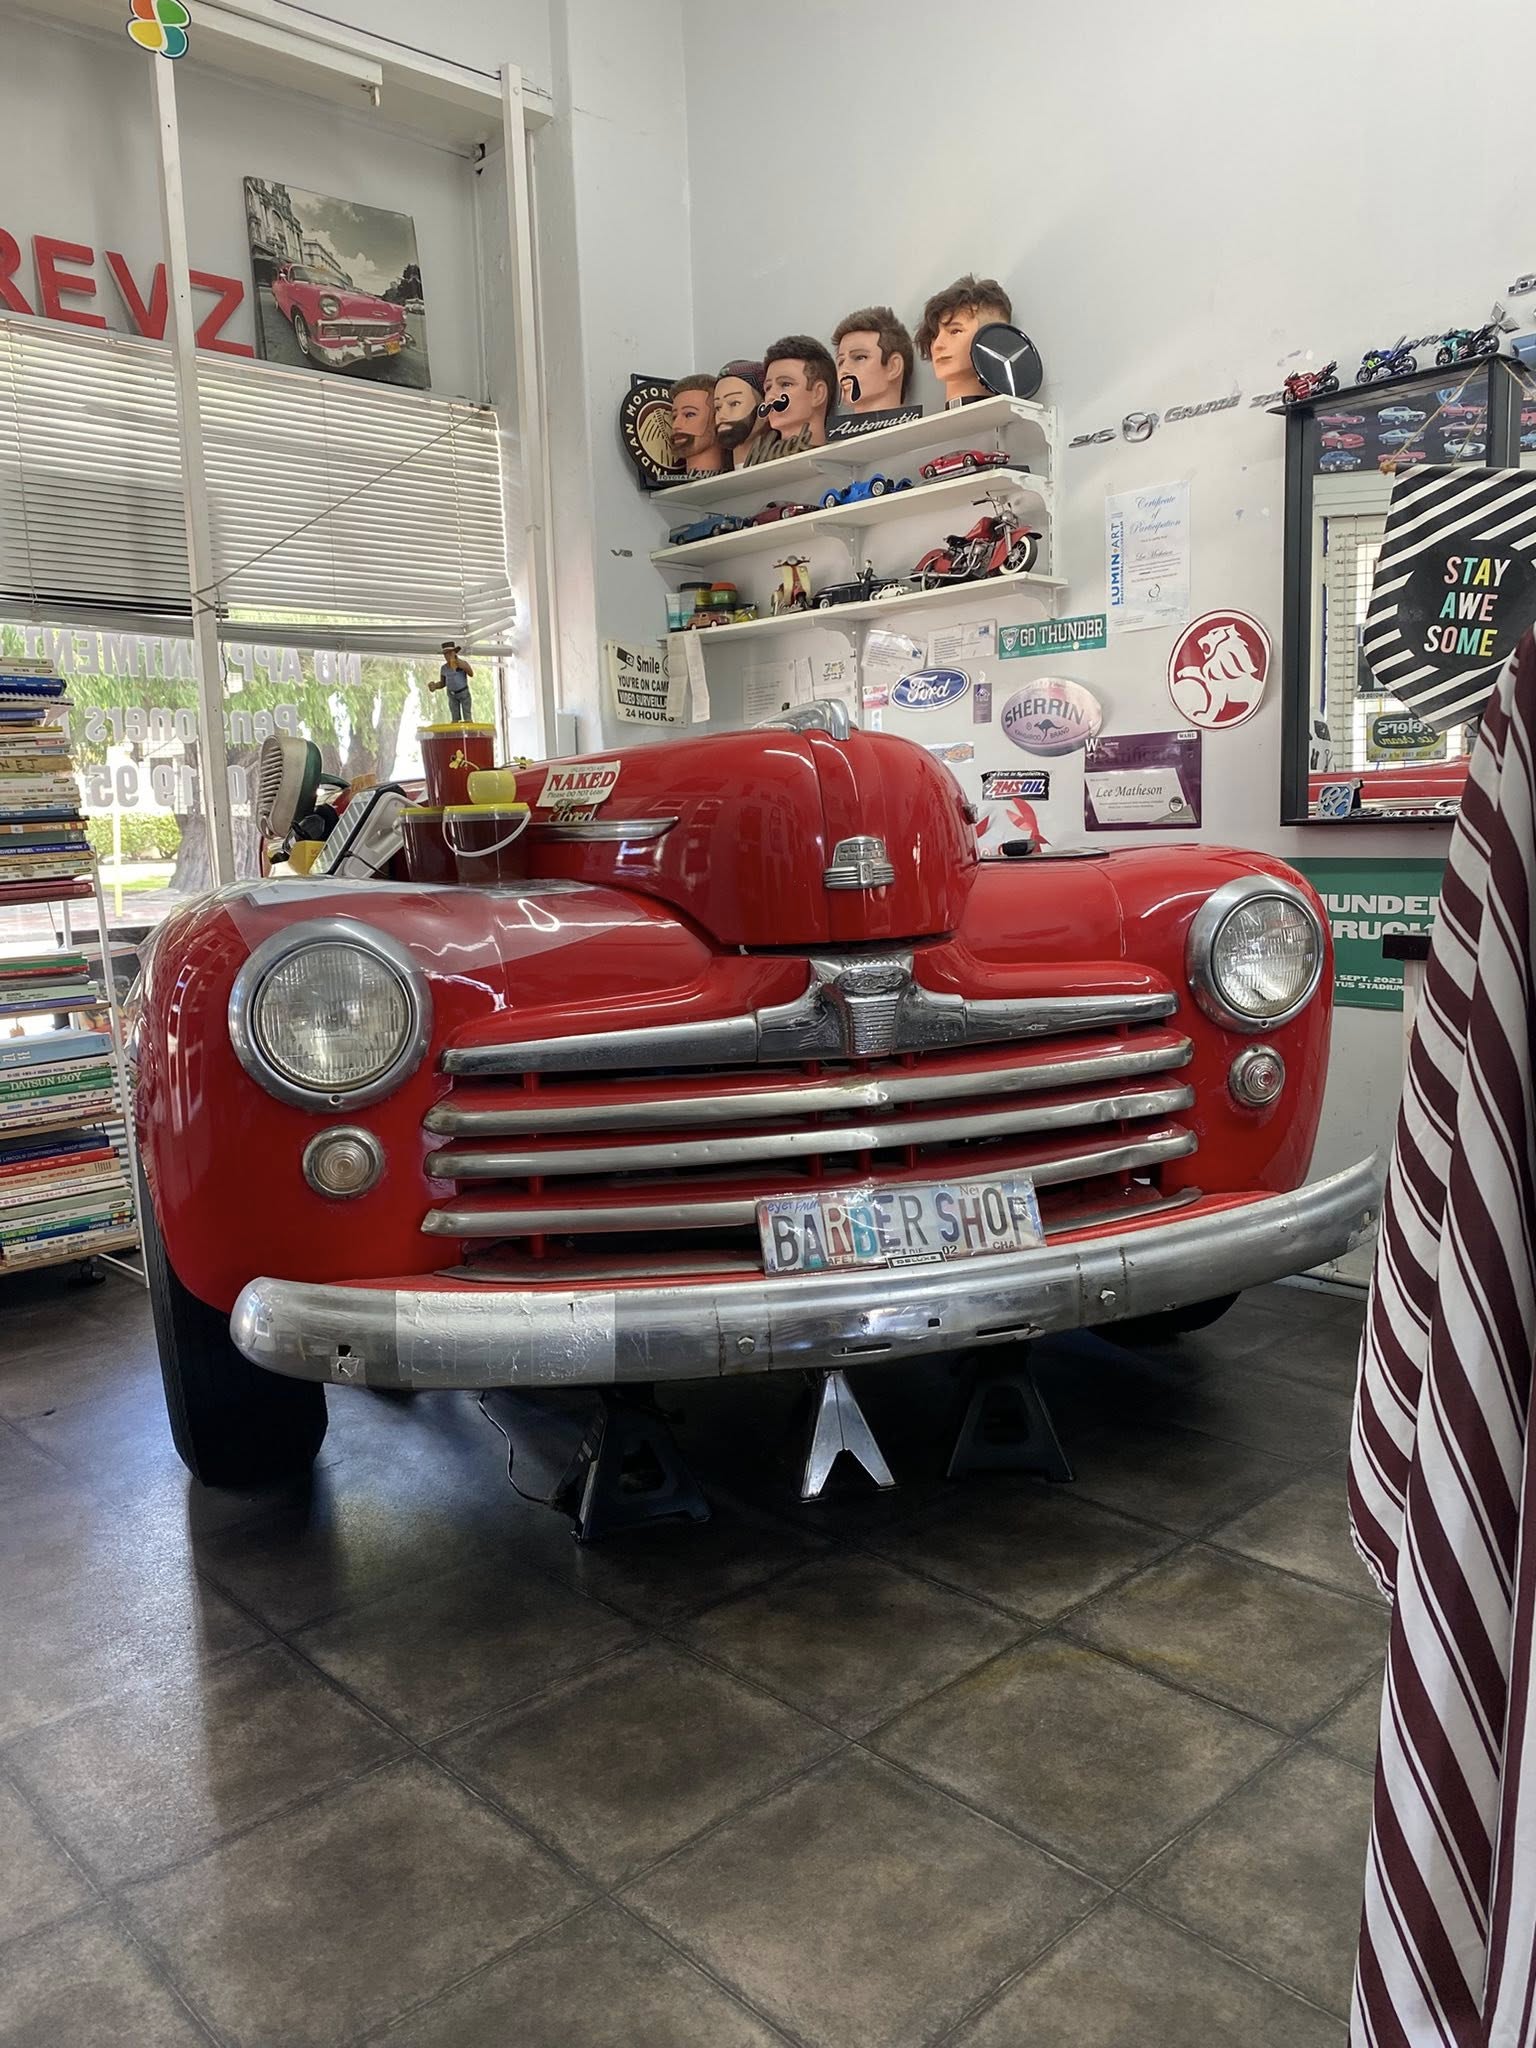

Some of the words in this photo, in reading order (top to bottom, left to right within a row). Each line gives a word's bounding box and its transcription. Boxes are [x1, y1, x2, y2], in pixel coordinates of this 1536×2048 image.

[0, 228, 255, 358] REVZ
[829, 412, 920, 437] Automatic
[743, 423, 813, 468] Mack
[1111, 523, 1121, 549] ART
[1111, 554, 1121, 606] LUMIN
[1443, 556, 1511, 587] STAY
[1439, 591, 1498, 621] AWE
[1019, 627, 1036, 647] GO
[1039, 618, 1103, 645] THUNDER
[1423, 625, 1498, 657] SOME
[636, 655, 660, 674] Smile
[618, 675, 639, 690] YOU'RE
[640, 679, 650, 691] ON
[907, 675, 952, 703] Ford
[625, 708, 636, 717] 24
[1004, 698, 1085, 730] SHERRIN
[1050, 727, 1070, 739] BRAND
[547, 771, 617, 791] NAKED
[988, 779, 1045, 796] AMSOIL
[1096, 786, 1113, 798] Lee
[1115, 784, 1163, 797] Matheson
[1358, 982, 1405, 991] STADIUM
[1373, 976, 1404, 984] 2023
[10, 1076, 56, 1091] DATSUN
[56, 1072, 82, 1084] 120Y
[771, 1194, 930, 1269] BARBER
[934, 1187, 1027, 1249] SHOP
[992, 1240, 1015, 1250] CHA
[896, 1255, 938, 1265] DELUXE
